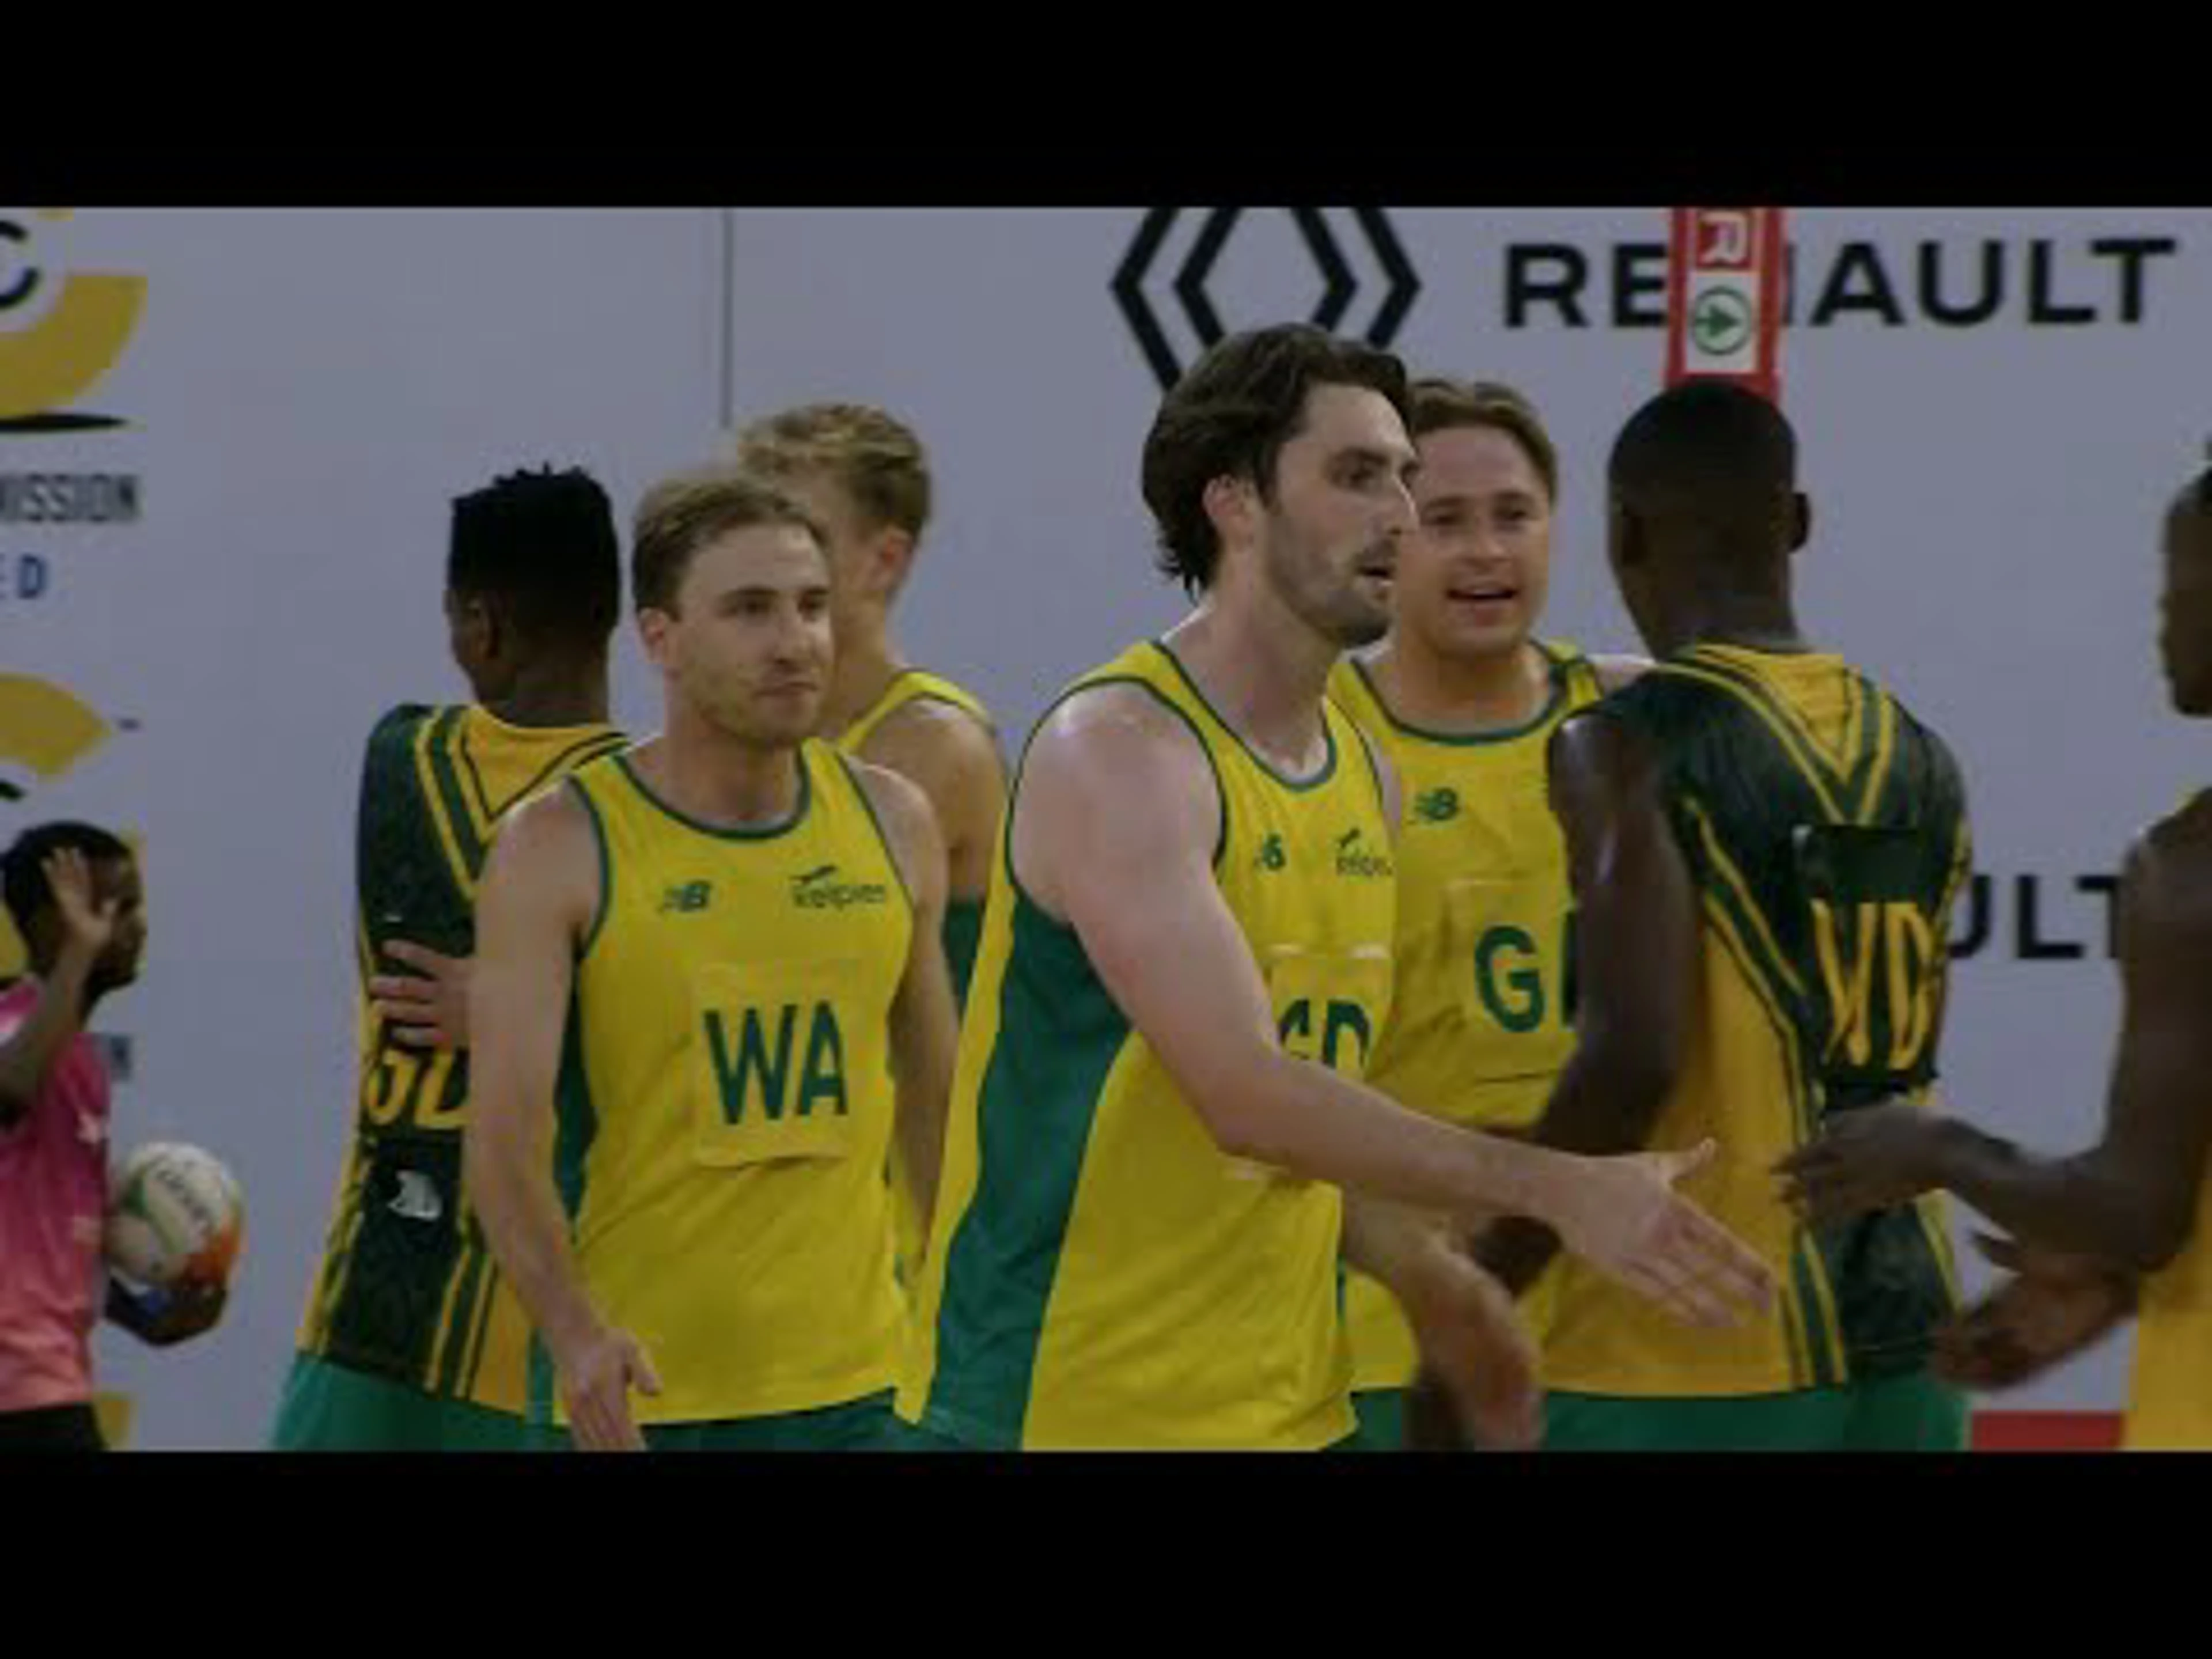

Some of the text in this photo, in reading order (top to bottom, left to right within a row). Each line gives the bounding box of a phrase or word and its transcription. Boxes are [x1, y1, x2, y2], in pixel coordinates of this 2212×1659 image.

[1503, 237, 2177, 328] REAULT
[0, 472, 141, 523] ISSION
[704, 1000, 848, 1126] WA
